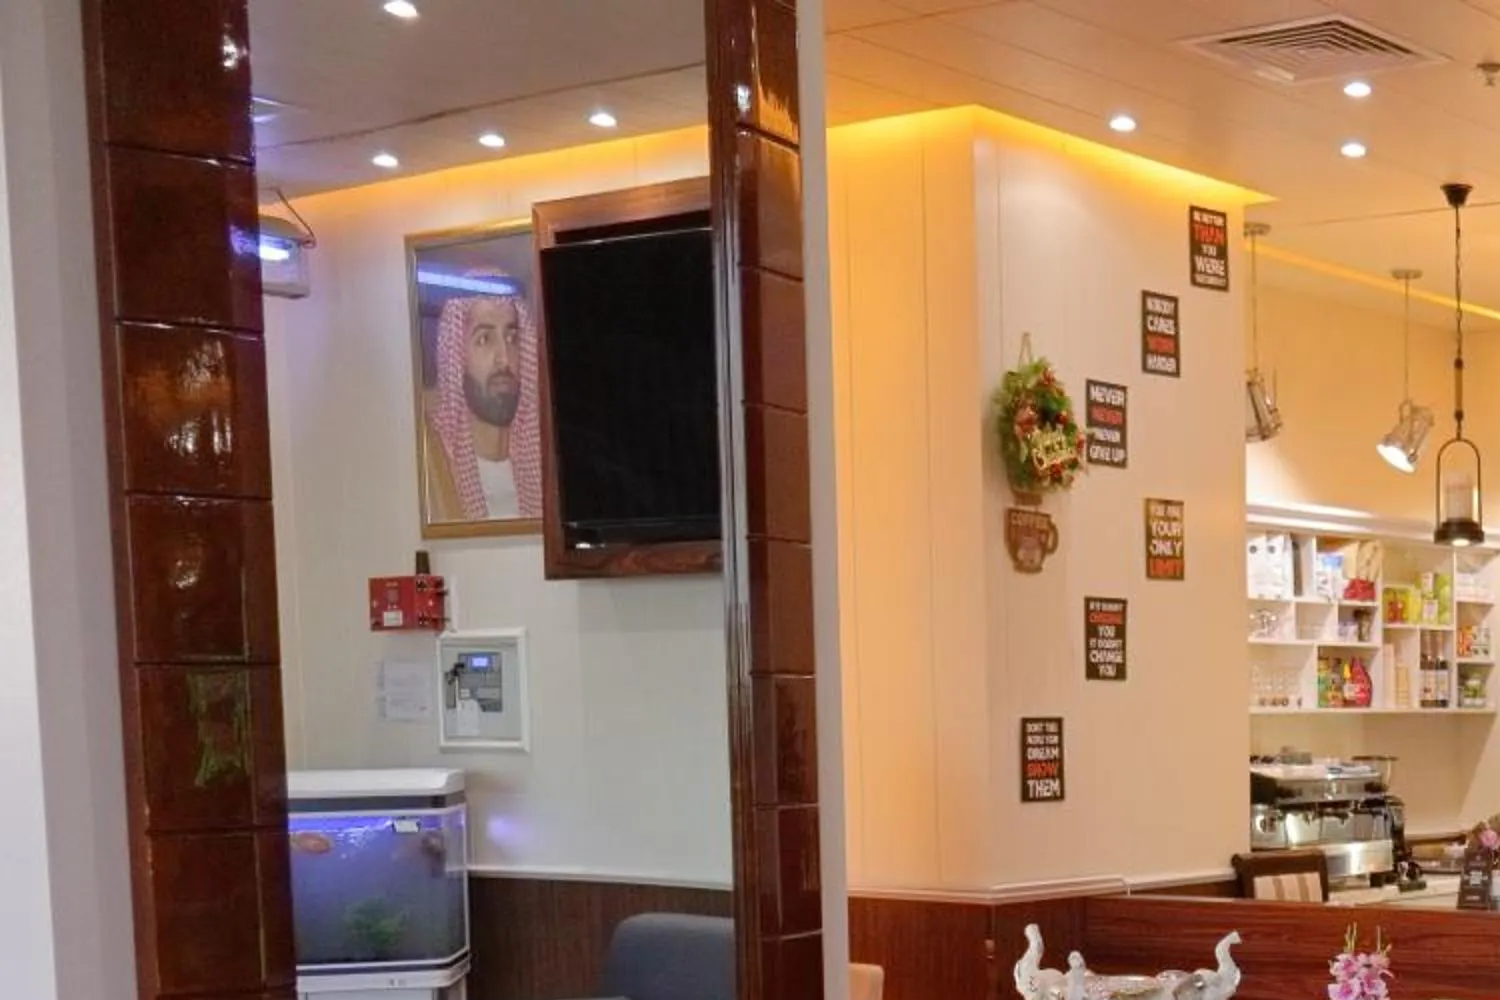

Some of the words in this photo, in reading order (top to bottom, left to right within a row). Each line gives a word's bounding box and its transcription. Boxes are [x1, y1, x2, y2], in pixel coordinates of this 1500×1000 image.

[1194, 256, 1225, 276] WERE
[1090, 384, 1125, 408] NEVER
[1150, 520, 1183, 537] YOUR
[1150, 539, 1182, 557] ONLY
[1098, 625, 1116, 638] YOU
[1098, 663, 1117, 677] YOU
[1026, 778, 1061, 798] THEM
